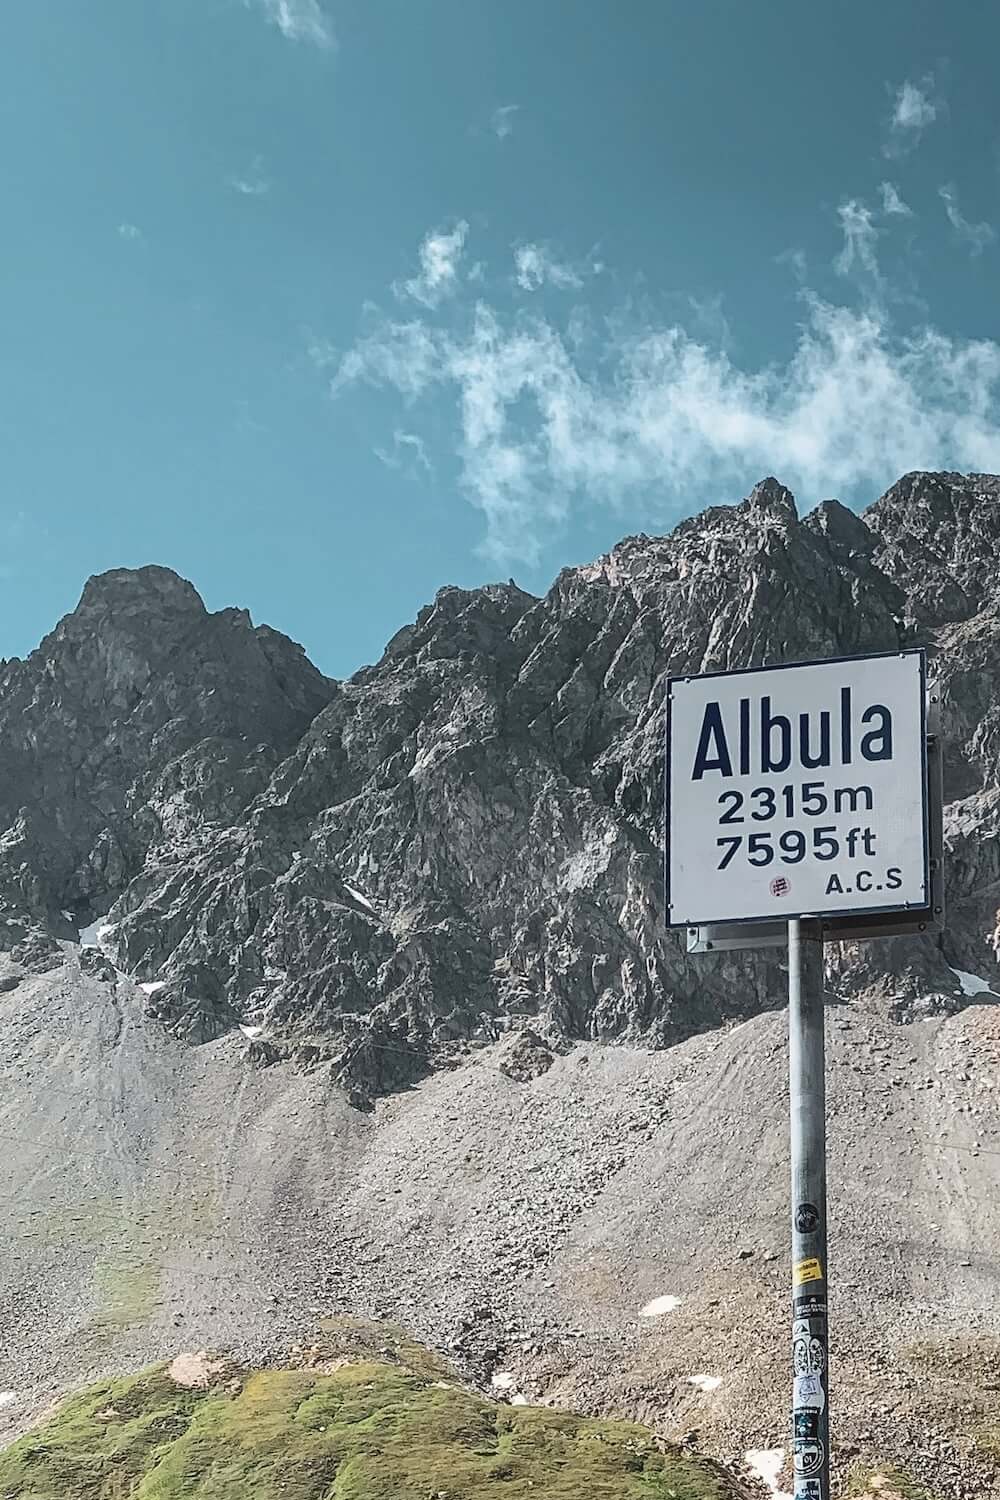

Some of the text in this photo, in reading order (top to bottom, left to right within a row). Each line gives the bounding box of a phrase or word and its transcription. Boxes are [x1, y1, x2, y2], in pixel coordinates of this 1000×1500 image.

[691, 686, 893, 781] Albula
[717, 781, 873, 825] 2315m
[716, 825, 877, 870] 7595ft
